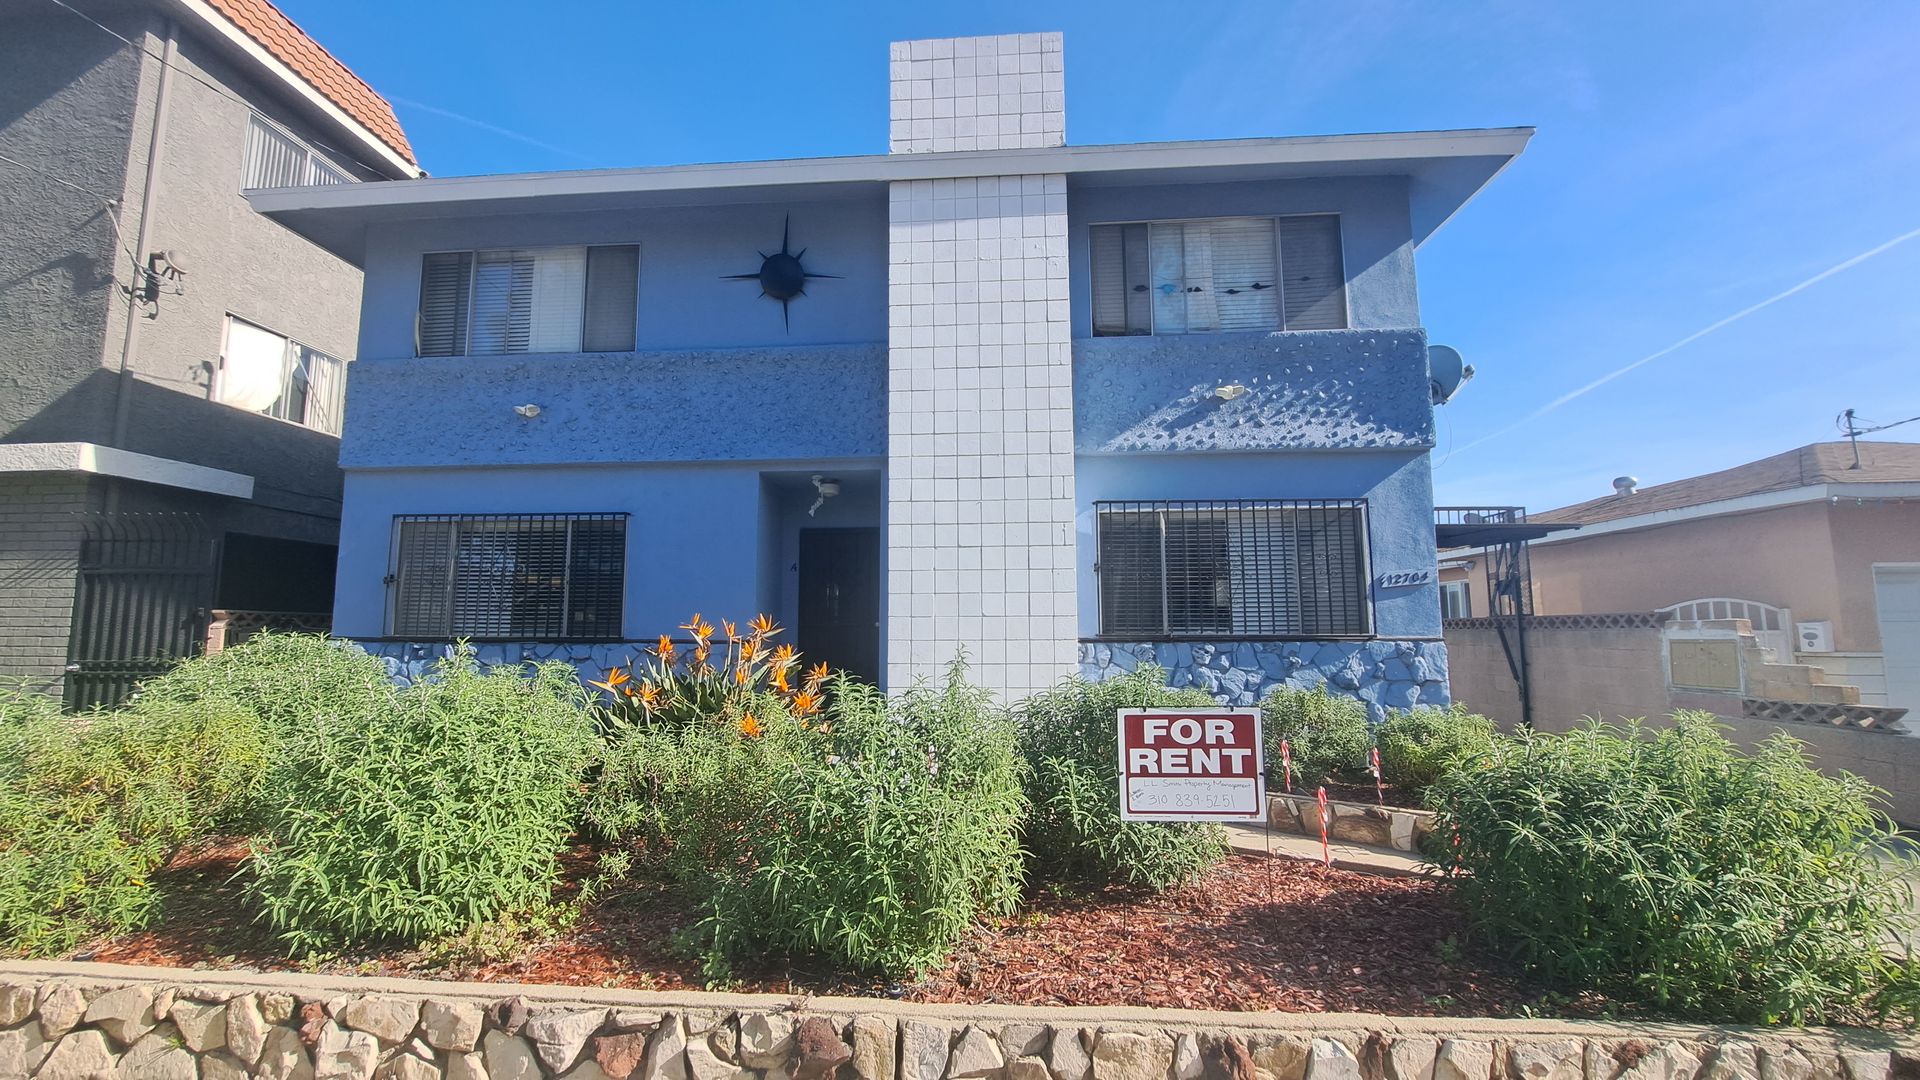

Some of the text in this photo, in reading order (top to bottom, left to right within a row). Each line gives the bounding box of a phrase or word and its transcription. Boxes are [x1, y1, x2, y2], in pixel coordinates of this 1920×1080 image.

[1387, 571, 1429, 585] 12704
[1143, 718, 1236, 745] FOR
[1129, 748, 1252, 774] RENT
[1184, 779, 1211, 791] Property
[1212, 780, 1252, 790] Management
[1148, 794, 1168, 805] 310
[1175, 793, 1236, 808] 839-5251
